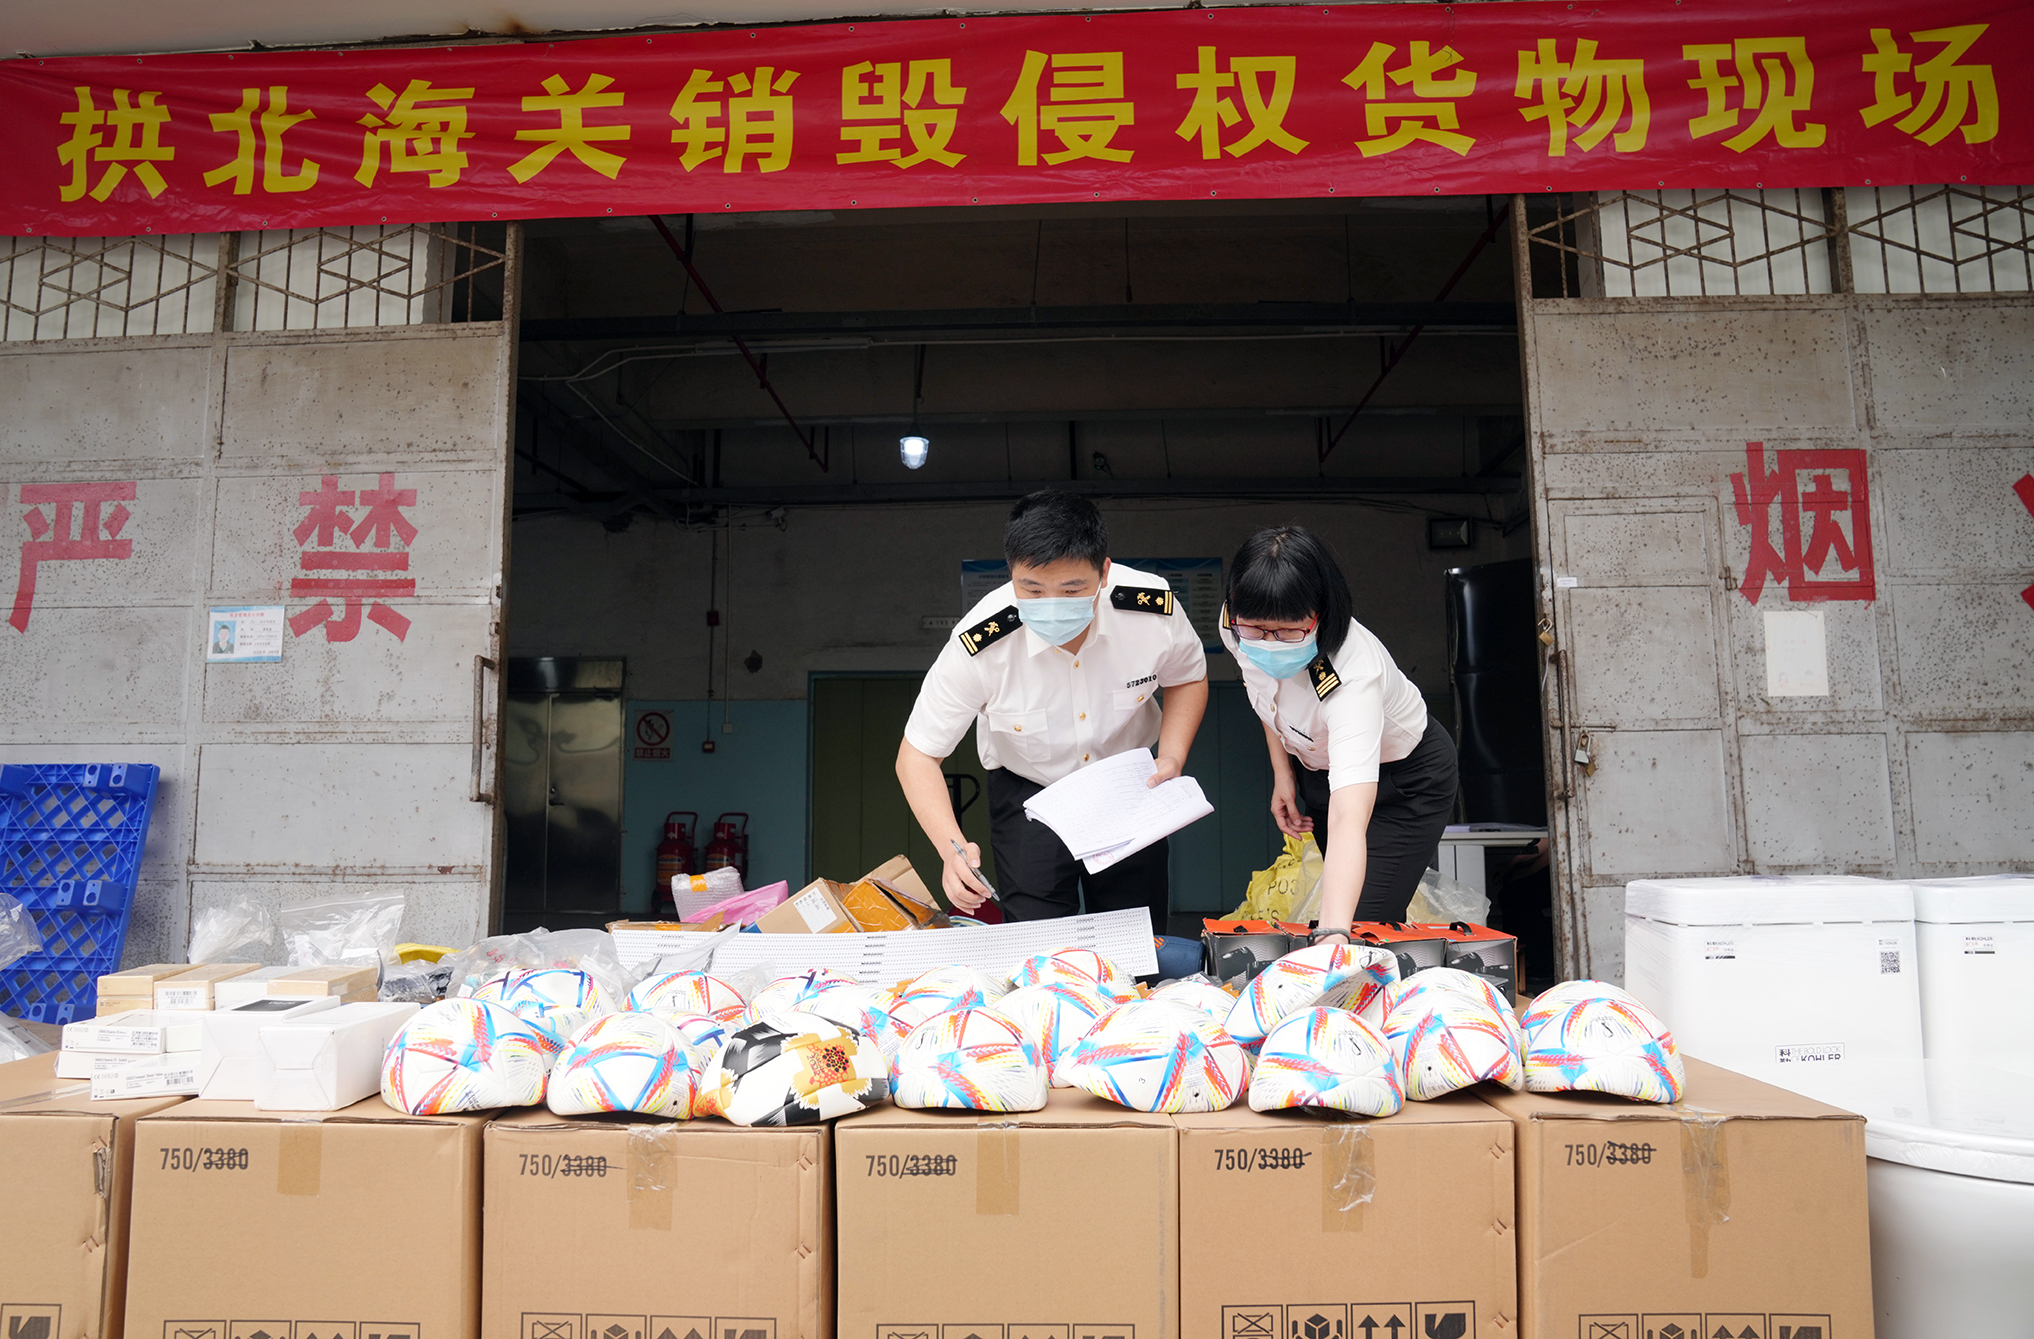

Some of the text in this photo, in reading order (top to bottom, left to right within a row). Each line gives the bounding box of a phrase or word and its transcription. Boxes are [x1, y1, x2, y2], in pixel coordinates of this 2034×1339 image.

[57, 23, 1999, 204] 拱北海关销毁侵权货物现场
